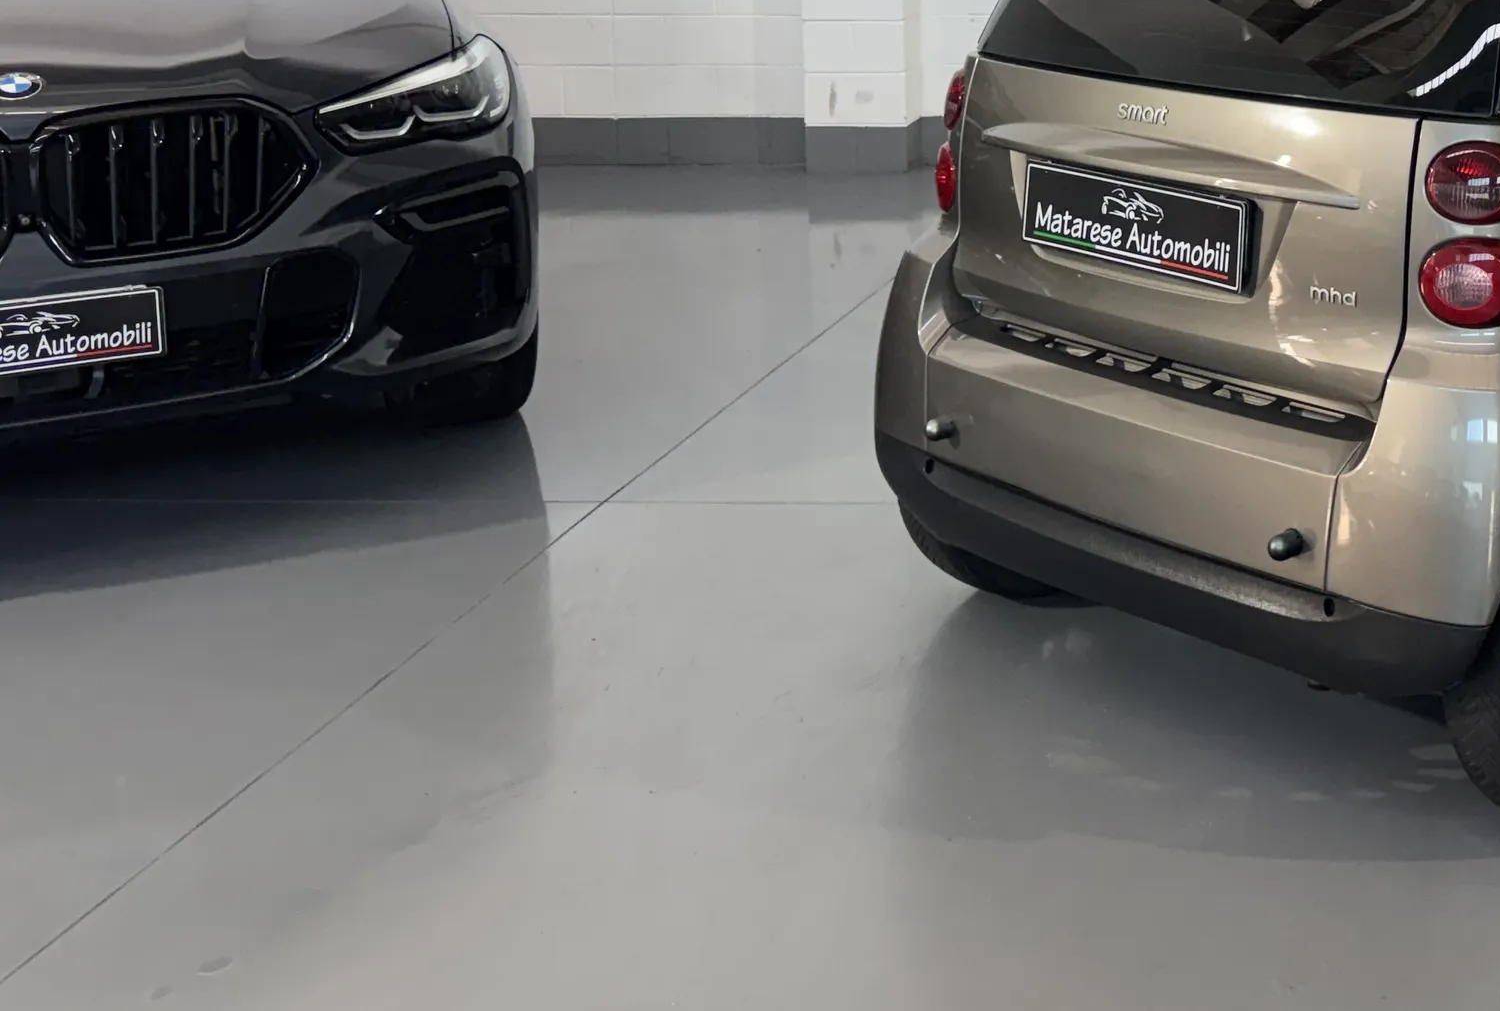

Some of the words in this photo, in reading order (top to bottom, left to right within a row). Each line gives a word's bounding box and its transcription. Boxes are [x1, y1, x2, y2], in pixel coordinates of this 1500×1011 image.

[1117, 102, 1169, 126] smart
[1034, 201, 1122, 246] Matarese
[1125, 222, 1231, 273] Automobili
[1309, 285, 1357, 307] mhd
[35, 321, 152, 358] Automobili
